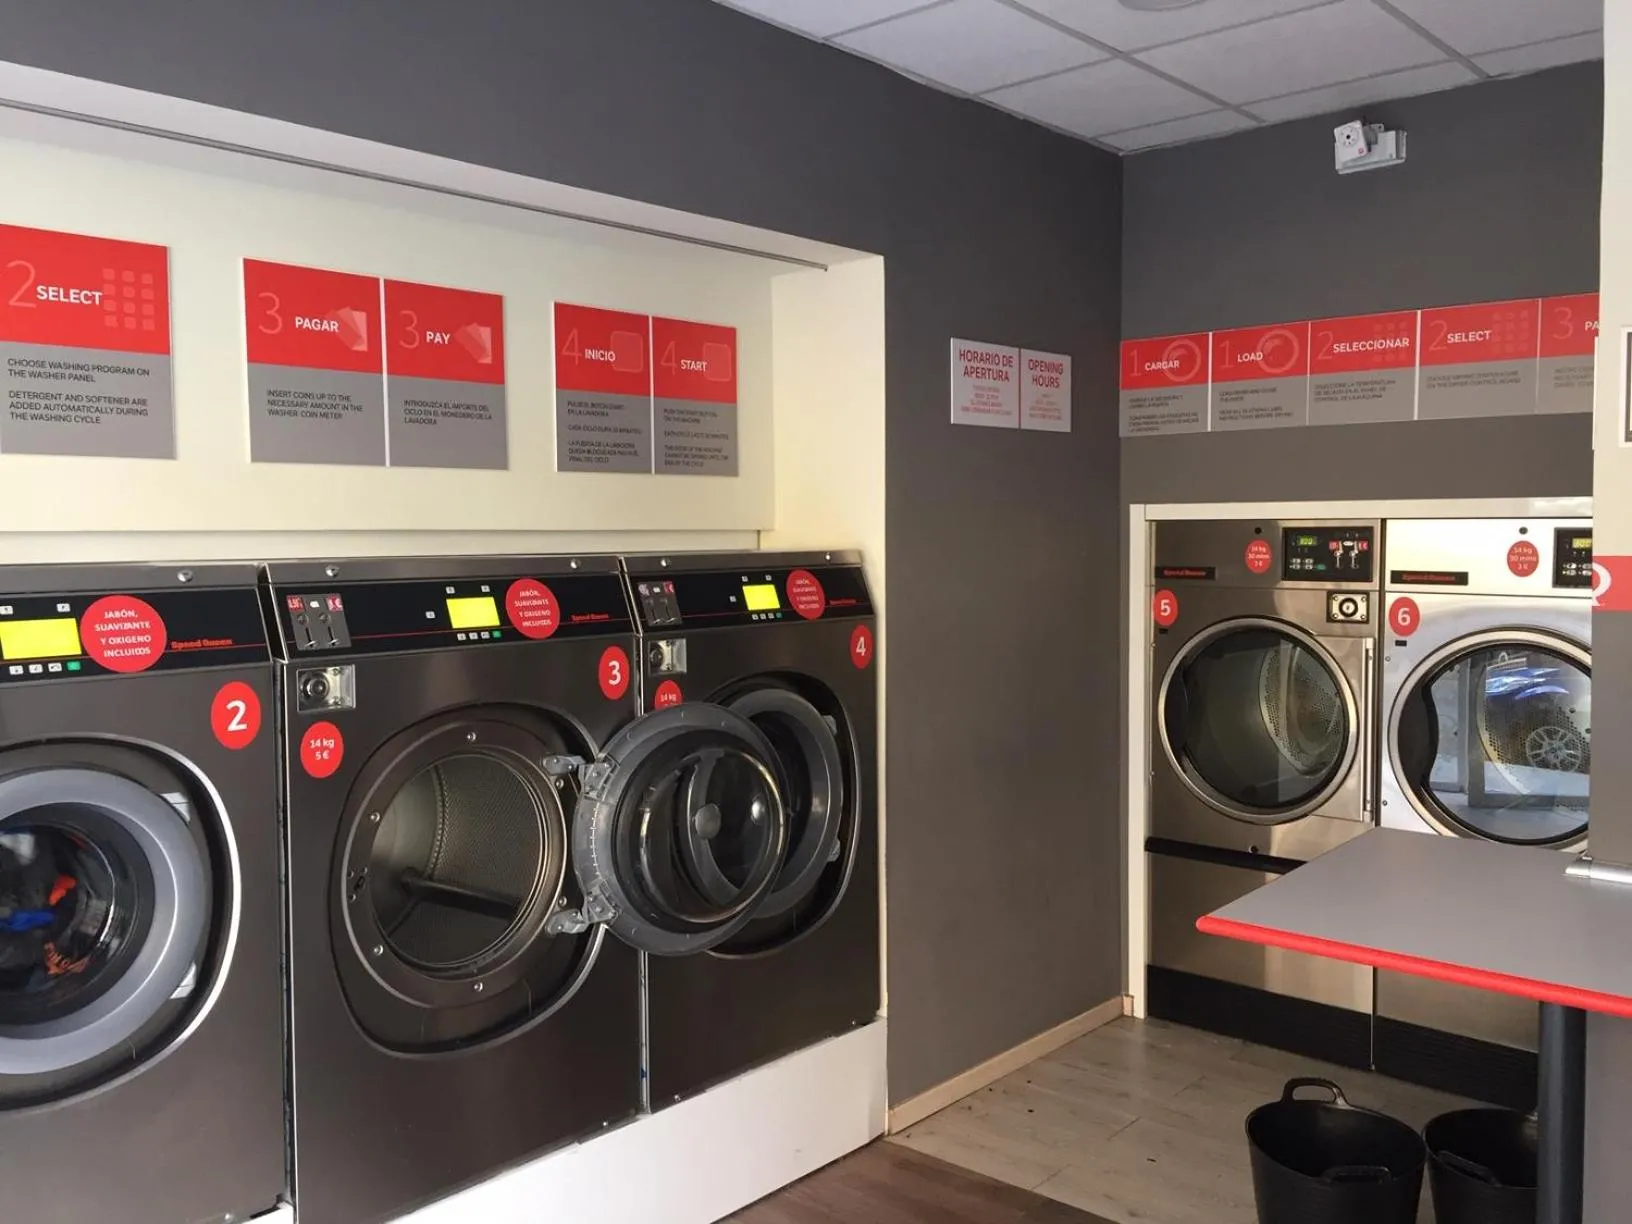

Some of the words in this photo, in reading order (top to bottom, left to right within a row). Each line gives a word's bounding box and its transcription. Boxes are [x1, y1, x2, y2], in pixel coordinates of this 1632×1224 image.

[6, 260, 37, 309] 2
[36, 285, 102, 305] SELECT
[258, 292, 283, 334] 3
[295, 316, 339, 332] PAGAR
[400, 309, 420, 349] 3
[426, 330, 451, 345] PAY
[1447, 330, 1492, 343] SELECT
[561, 327, 582, 365] 4
[584, 348, 616, 362] INICIO
[1333, 337, 1410, 354] SELECCIONAR
[660, 340, 677, 376] 4
[681, 359, 708, 372] START
[959, 349, 1000, 366] HORARIO
[1002, 356, 1014, 368] DE
[1145, 359, 1180, 371] CARGAR
[1237, 351, 1263, 363] LOAD
[8, 358, 48, 368] CHOOSE
[48, 361, 90, 372] WASHING
[92, 364, 135, 375] PROGRAM
[136, 367, 150, 376] ON
[963, 366, 1010, 382] APERTURA
[1028, 359, 1063, 375] OPENING
[8, 369, 27, 378] THE
[28, 370, 66, 380] WASHER
[68, 372, 96, 383] PANEL
[1032, 375, 1060, 389] HOURS
[9, 390, 64, 401] DETERGENT
[65, 393, 84, 403] AND
[85, 395, 130, 405] SOFTENER
[131, 398, 148, 406] ARE
[267, 389, 292, 398] INSERT
[293, 391, 315, 400] COINS
[338, 394, 352, 402] THE
[10, 401, 42, 411] ADDED
[43, 403, 113, 415] AUTOMATICALLY
[116, 407, 149, 417] DURING
[268, 409, 298, 417] WASHER
[300, 410, 318, 418] COIN
[319, 411, 343, 419] METER
[310, 402, 340, 410] AMOUNT
[342, 403, 349, 411] IN
[350, 404, 364, 412] THE
[10, 411, 28, 420] THE
[30, 413, 73, 423] WASHING
[105, 609, 138, 619] JABÓN,
[1161, 600, 1171, 616] 5
[1397, 607, 1410, 626] 6
[94, 621, 151, 632] SUAVIZANTE
[103, 647, 151, 657] INCLUIDOS
[171, 639, 202, 650] Speed
[203, 638, 233, 647] Queen
[856, 637, 866, 656] 4
[608, 660, 621, 685] 3
[226, 700, 248, 732] 2
[310, 739, 322, 748] 14
[323, 738, 335, 750] kg
